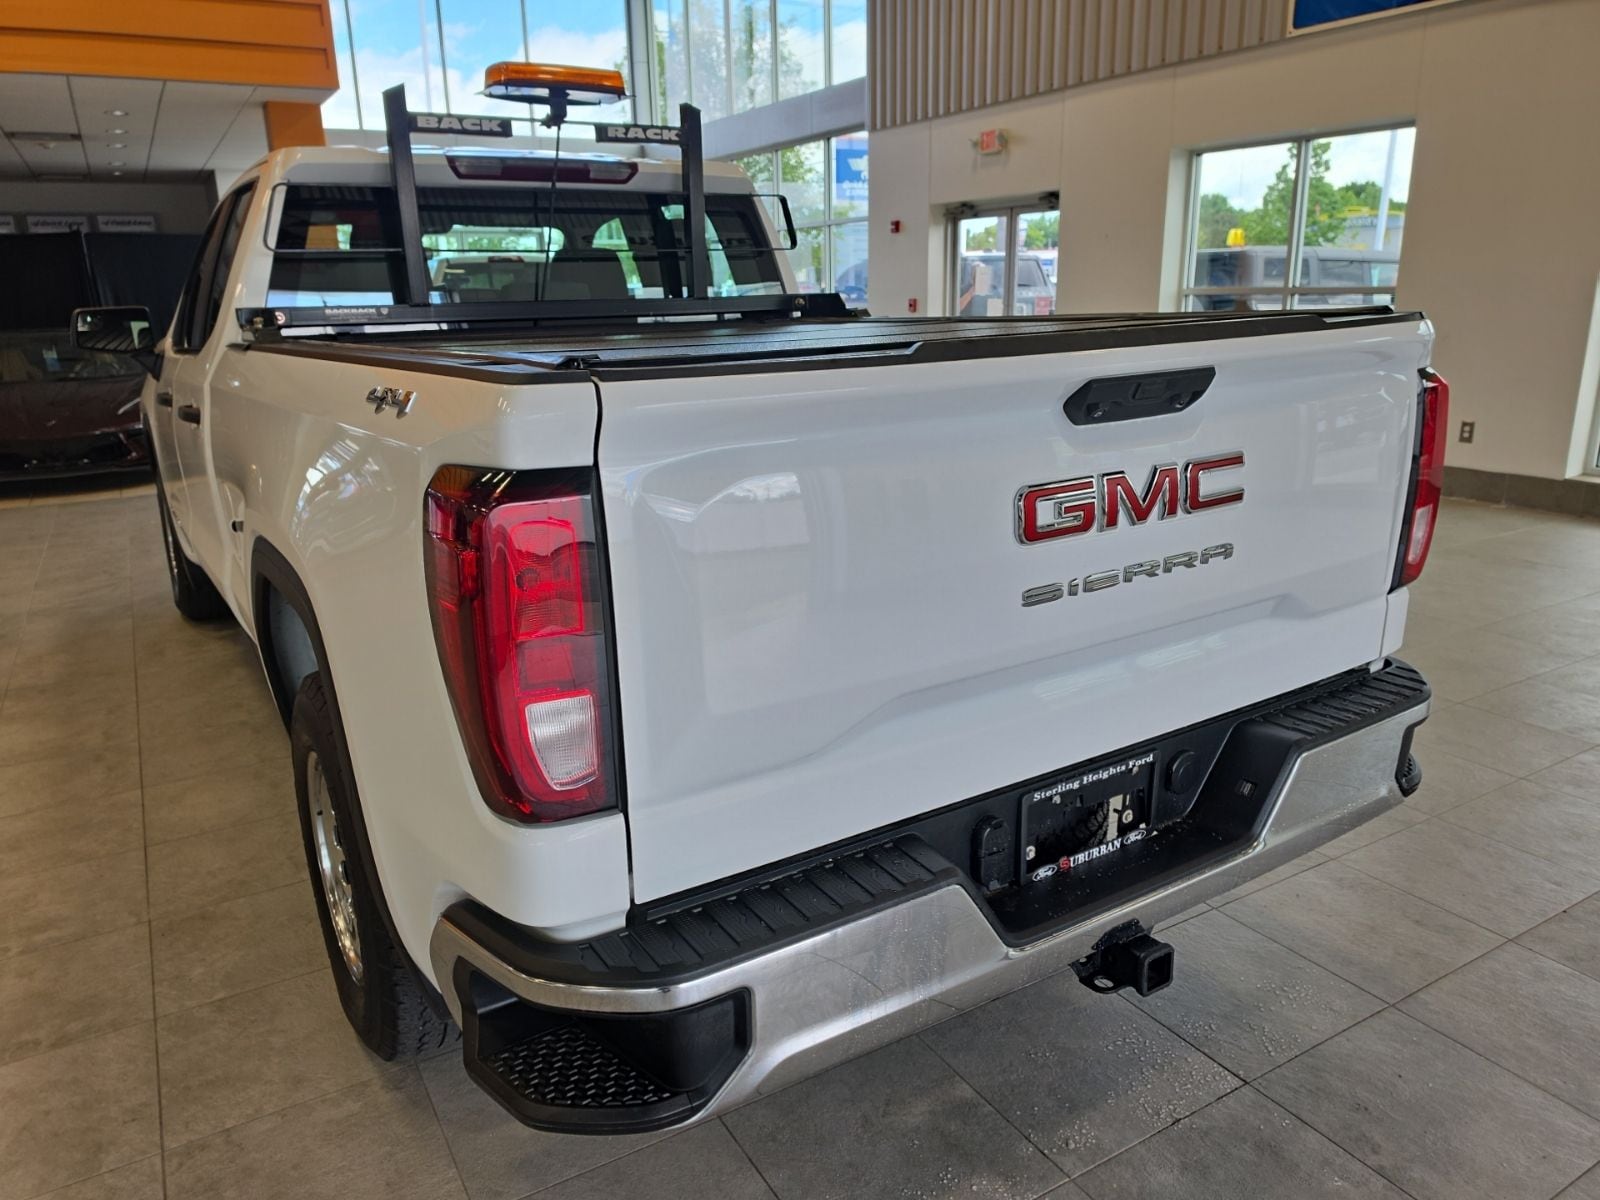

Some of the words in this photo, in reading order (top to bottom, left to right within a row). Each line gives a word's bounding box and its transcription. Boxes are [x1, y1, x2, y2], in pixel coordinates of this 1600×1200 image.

[416, 115, 504, 132] BACK
[607, 126, 682, 142] RACK
[1014, 450, 1245, 545] GMC
[1021, 542, 1235, 608] SIERRA
[1033, 779, 1080, 802] Sterling
[1082, 765, 1127, 785] Heights
[1128, 753, 1154, 769] Ford
[1059, 838, 1122, 871] SUBURBAN
